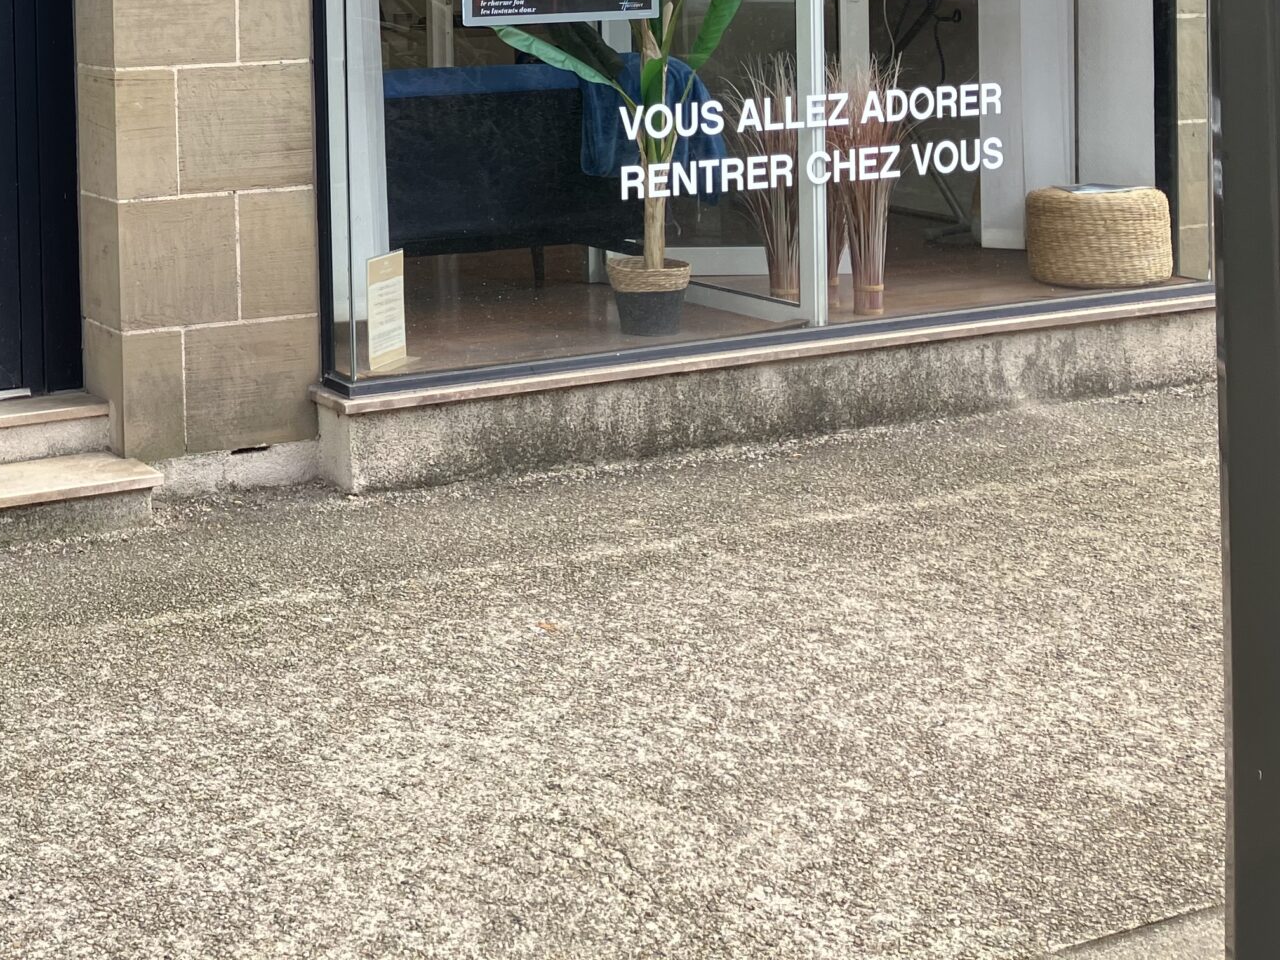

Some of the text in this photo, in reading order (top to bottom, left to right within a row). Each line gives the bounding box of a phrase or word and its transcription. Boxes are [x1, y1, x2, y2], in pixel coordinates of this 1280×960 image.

[619, 82, 1002, 140] VOUS ALLEZ ADORER
[621, 137, 1004, 201] RENTRER CHEZ VOUS
